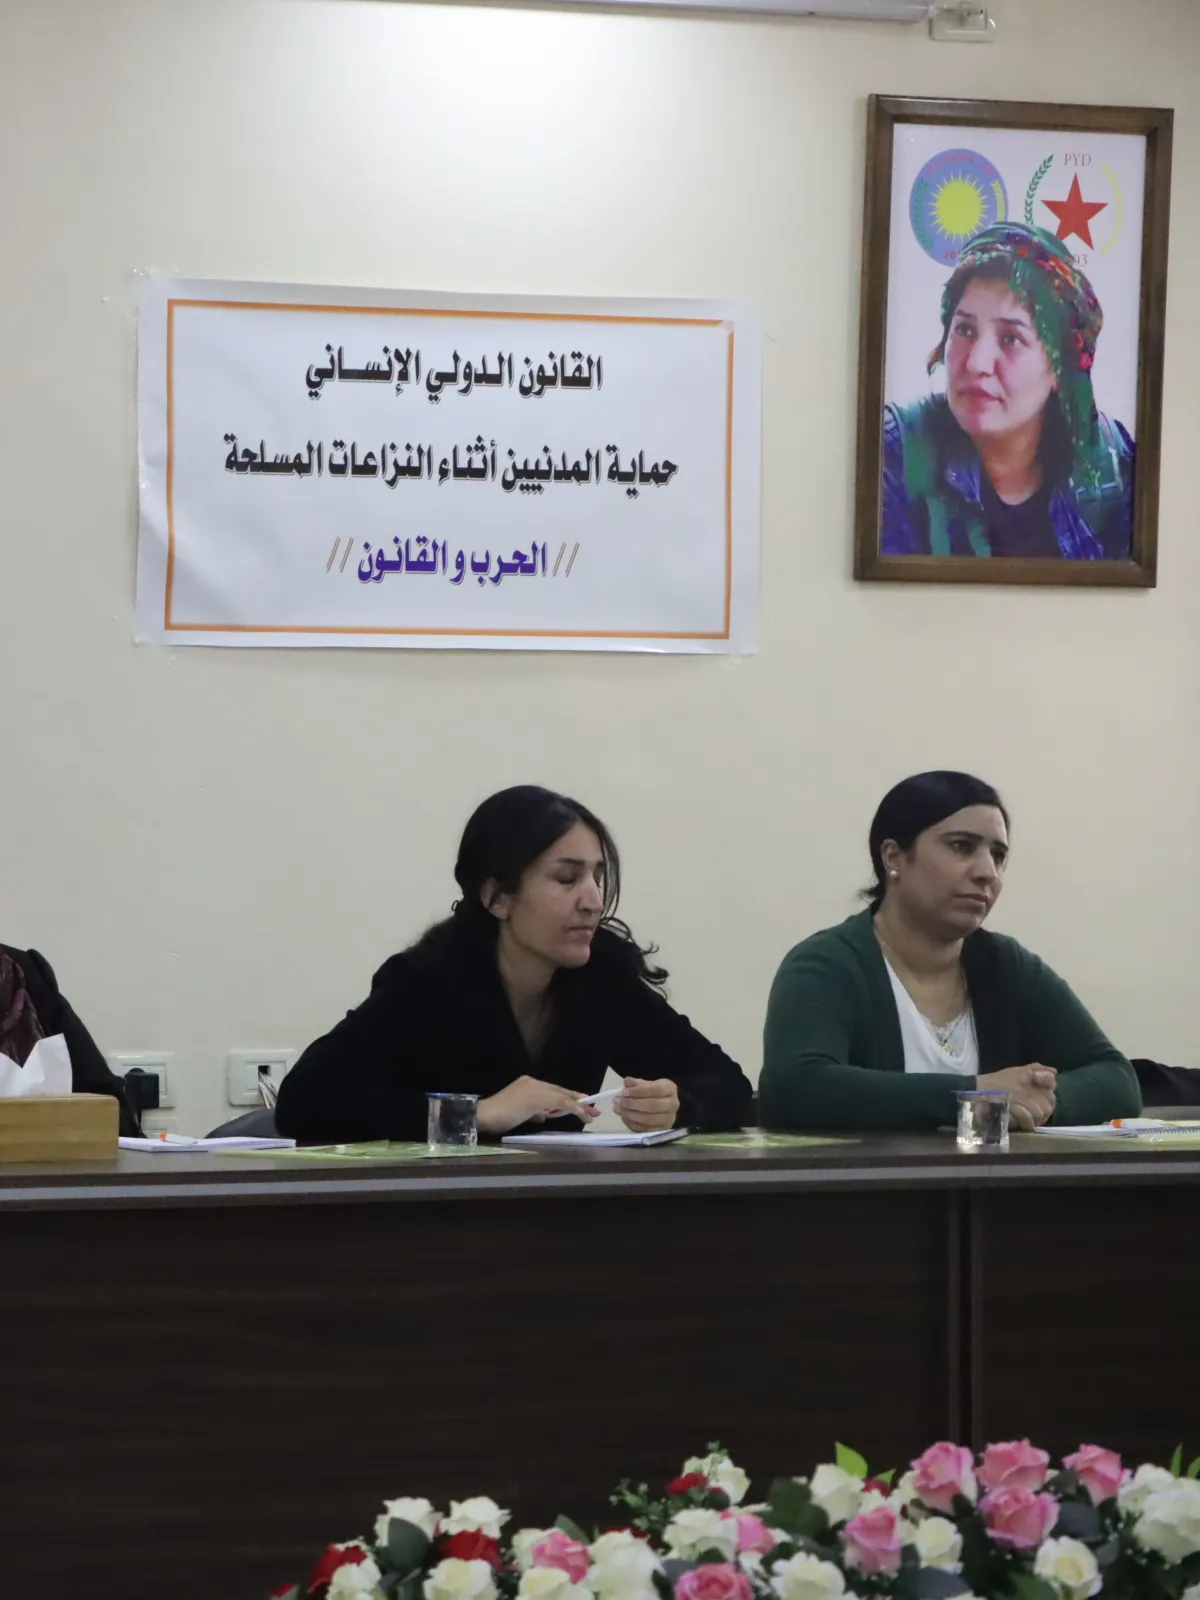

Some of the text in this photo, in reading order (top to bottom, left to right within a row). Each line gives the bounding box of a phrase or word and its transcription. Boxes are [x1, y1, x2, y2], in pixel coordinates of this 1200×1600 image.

[1064, 152, 1092, 167] PYD
[305, 343, 603, 403] القانون الدولي الإنساني
[223, 433, 678, 498] حماية المدنيين أثناء النزاعات المسلحة
[357, 535, 448, 583] القانون
[450, 549, 466, 584] و
[470, 540, 547, 586] الحرب
